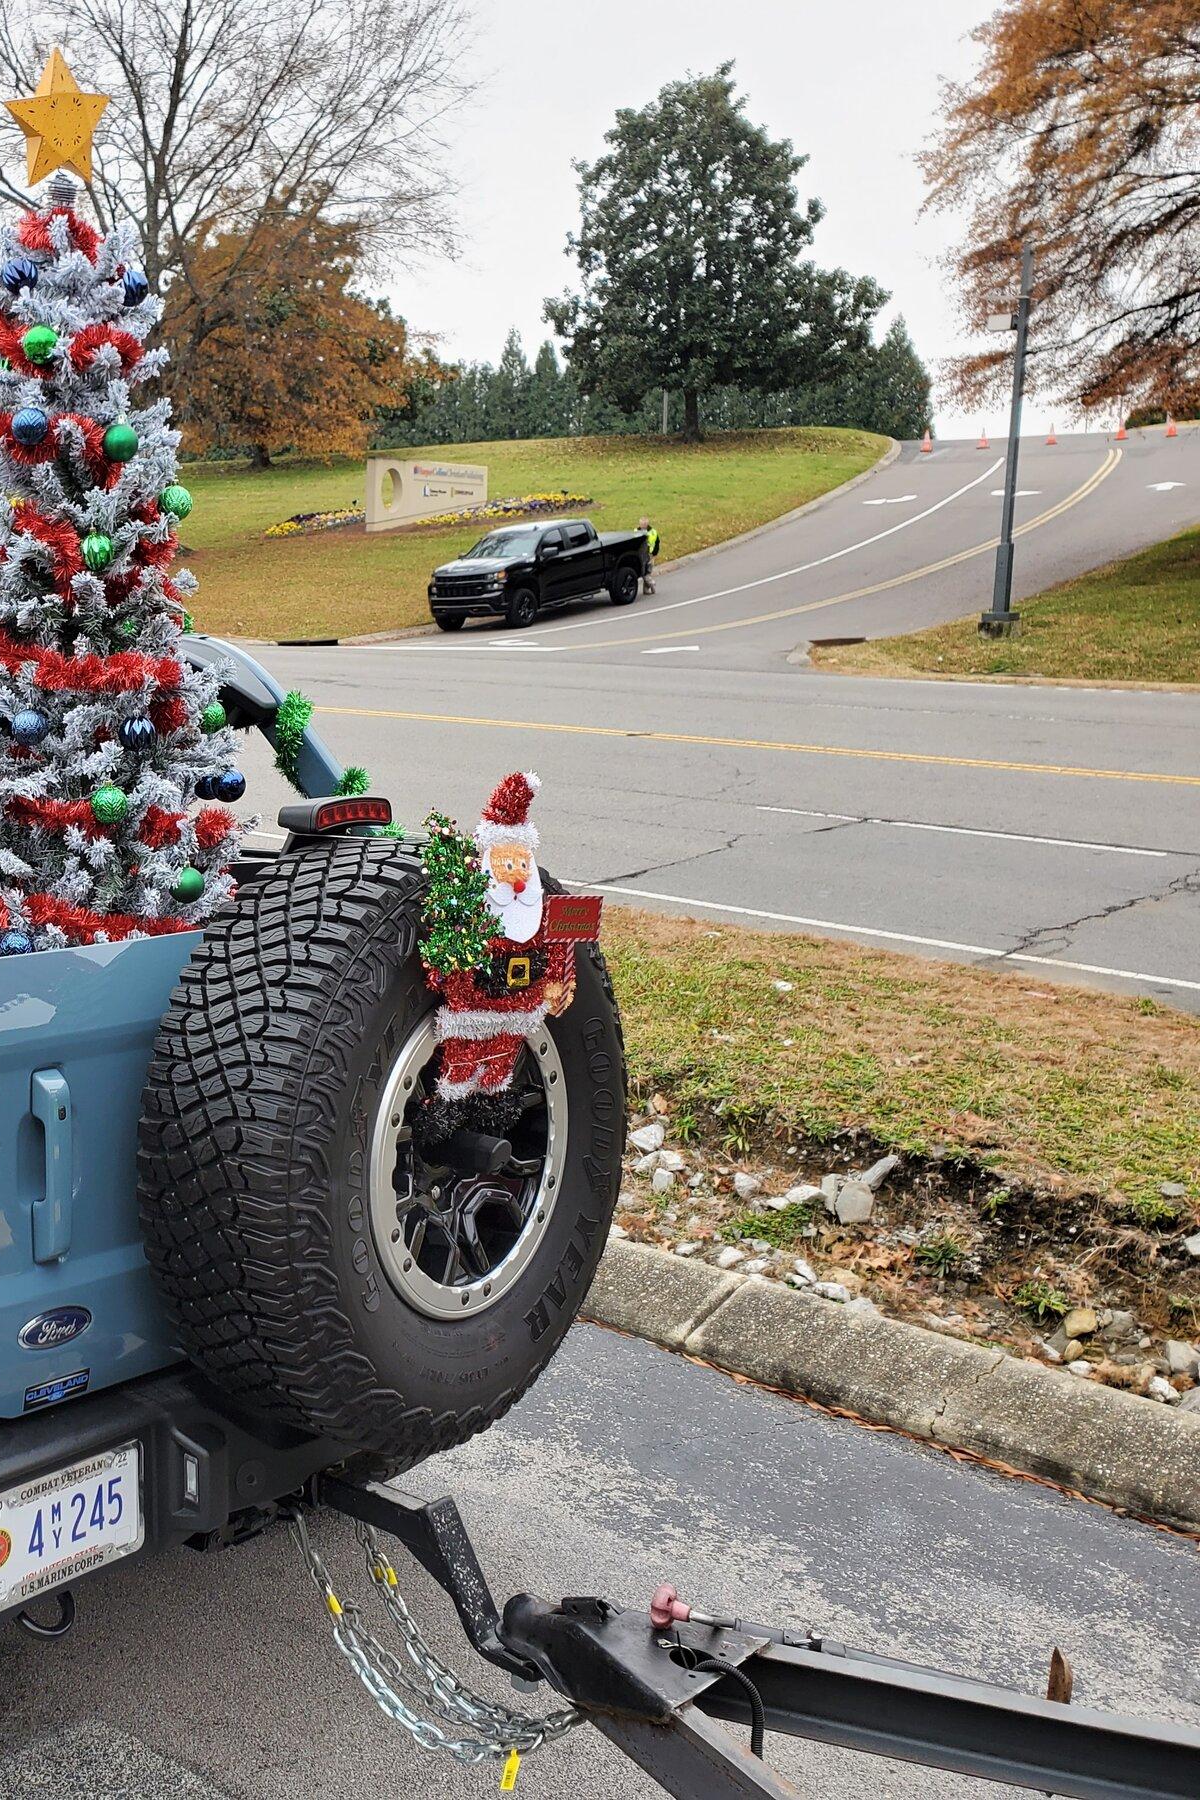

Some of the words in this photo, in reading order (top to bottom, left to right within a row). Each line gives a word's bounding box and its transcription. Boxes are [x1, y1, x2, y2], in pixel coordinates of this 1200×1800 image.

[562, 906, 589, 917] Merry
[550, 920, 596, 932] Christmas
[38, 1319, 76, 1344] Ford
[26, 1375, 89, 1401] CLEVELAND
[20, 1478, 60, 1500] COMBAT
[60, 1459, 104, 1484] VETERAN
[28, 1509, 45, 1558] 4
[70, 1476, 123, 1542] 245
[36, 1564, 75, 1588] MARINE
[74, 1551, 104, 1573] CORPS
